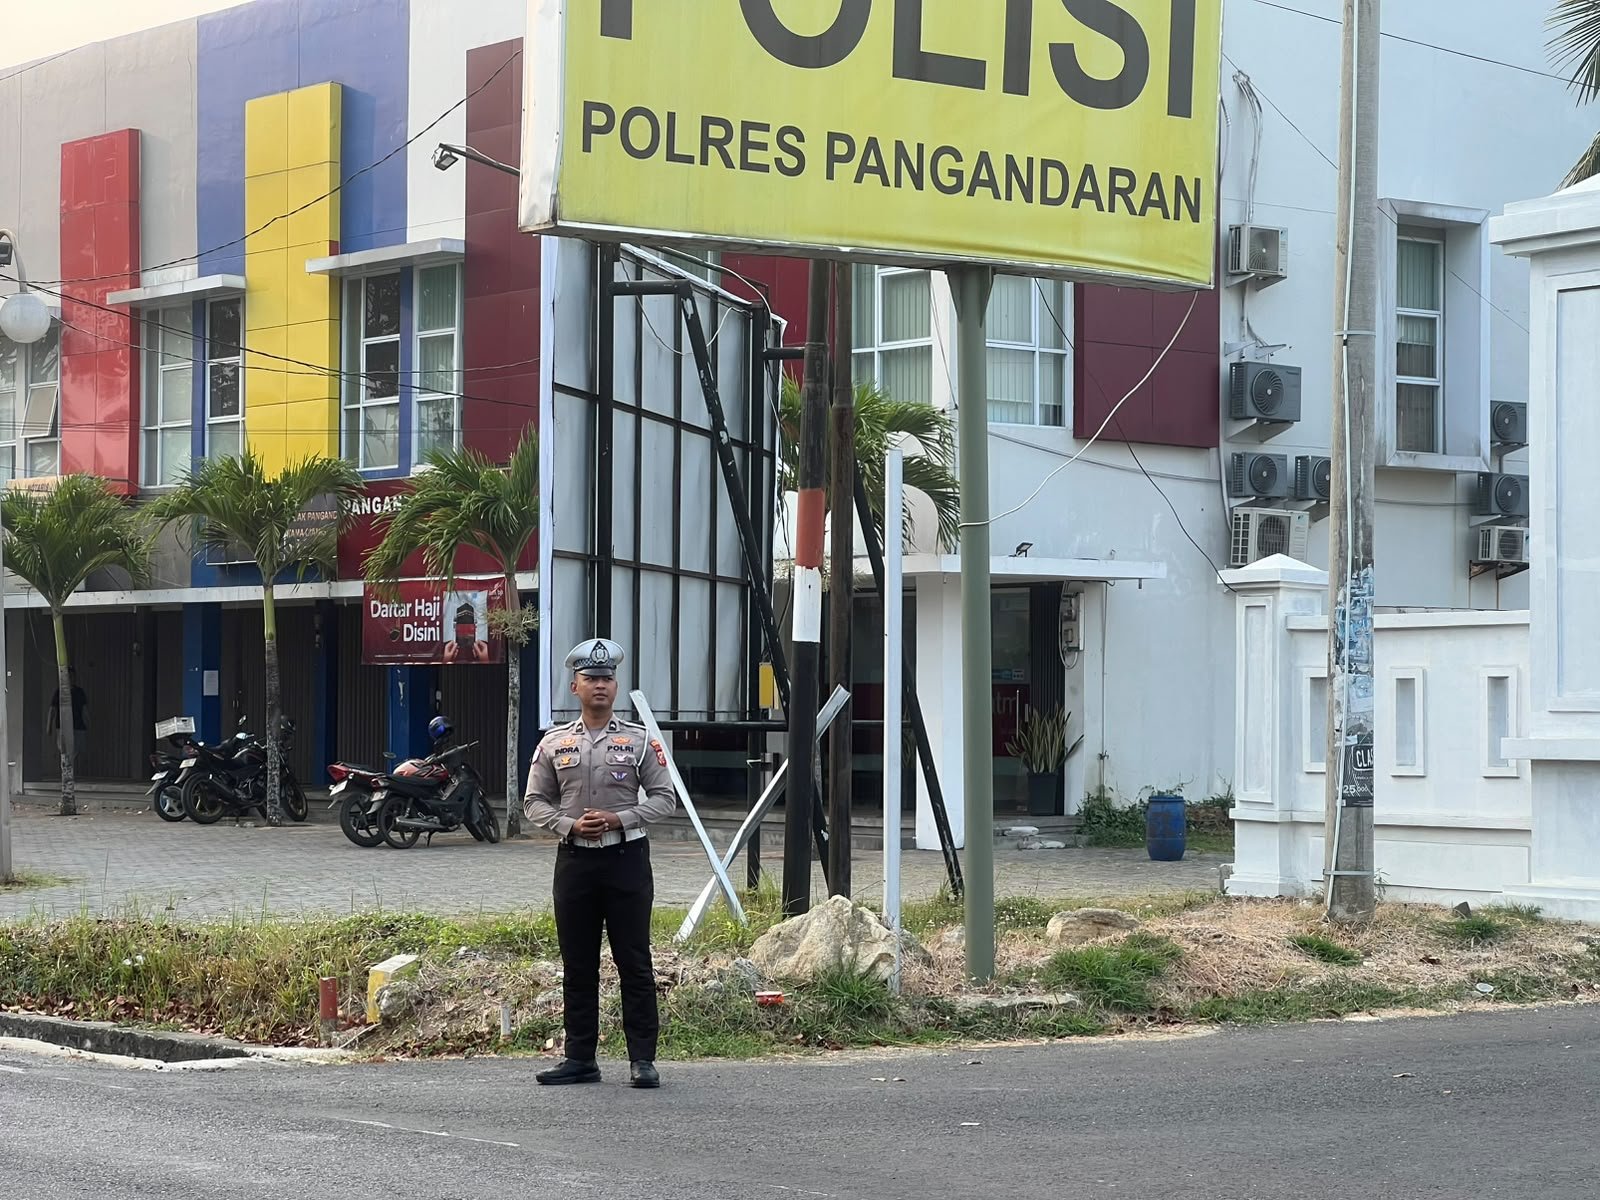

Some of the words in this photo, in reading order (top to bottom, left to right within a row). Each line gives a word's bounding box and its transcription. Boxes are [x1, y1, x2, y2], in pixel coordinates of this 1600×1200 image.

[582, 101, 806, 177] POLRES
[825, 131, 1201, 224] PANGANDARAN
[414, 596, 440, 621] Haji
[403, 621, 440, 642] Disini
[555, 746, 580, 755] INDRA
